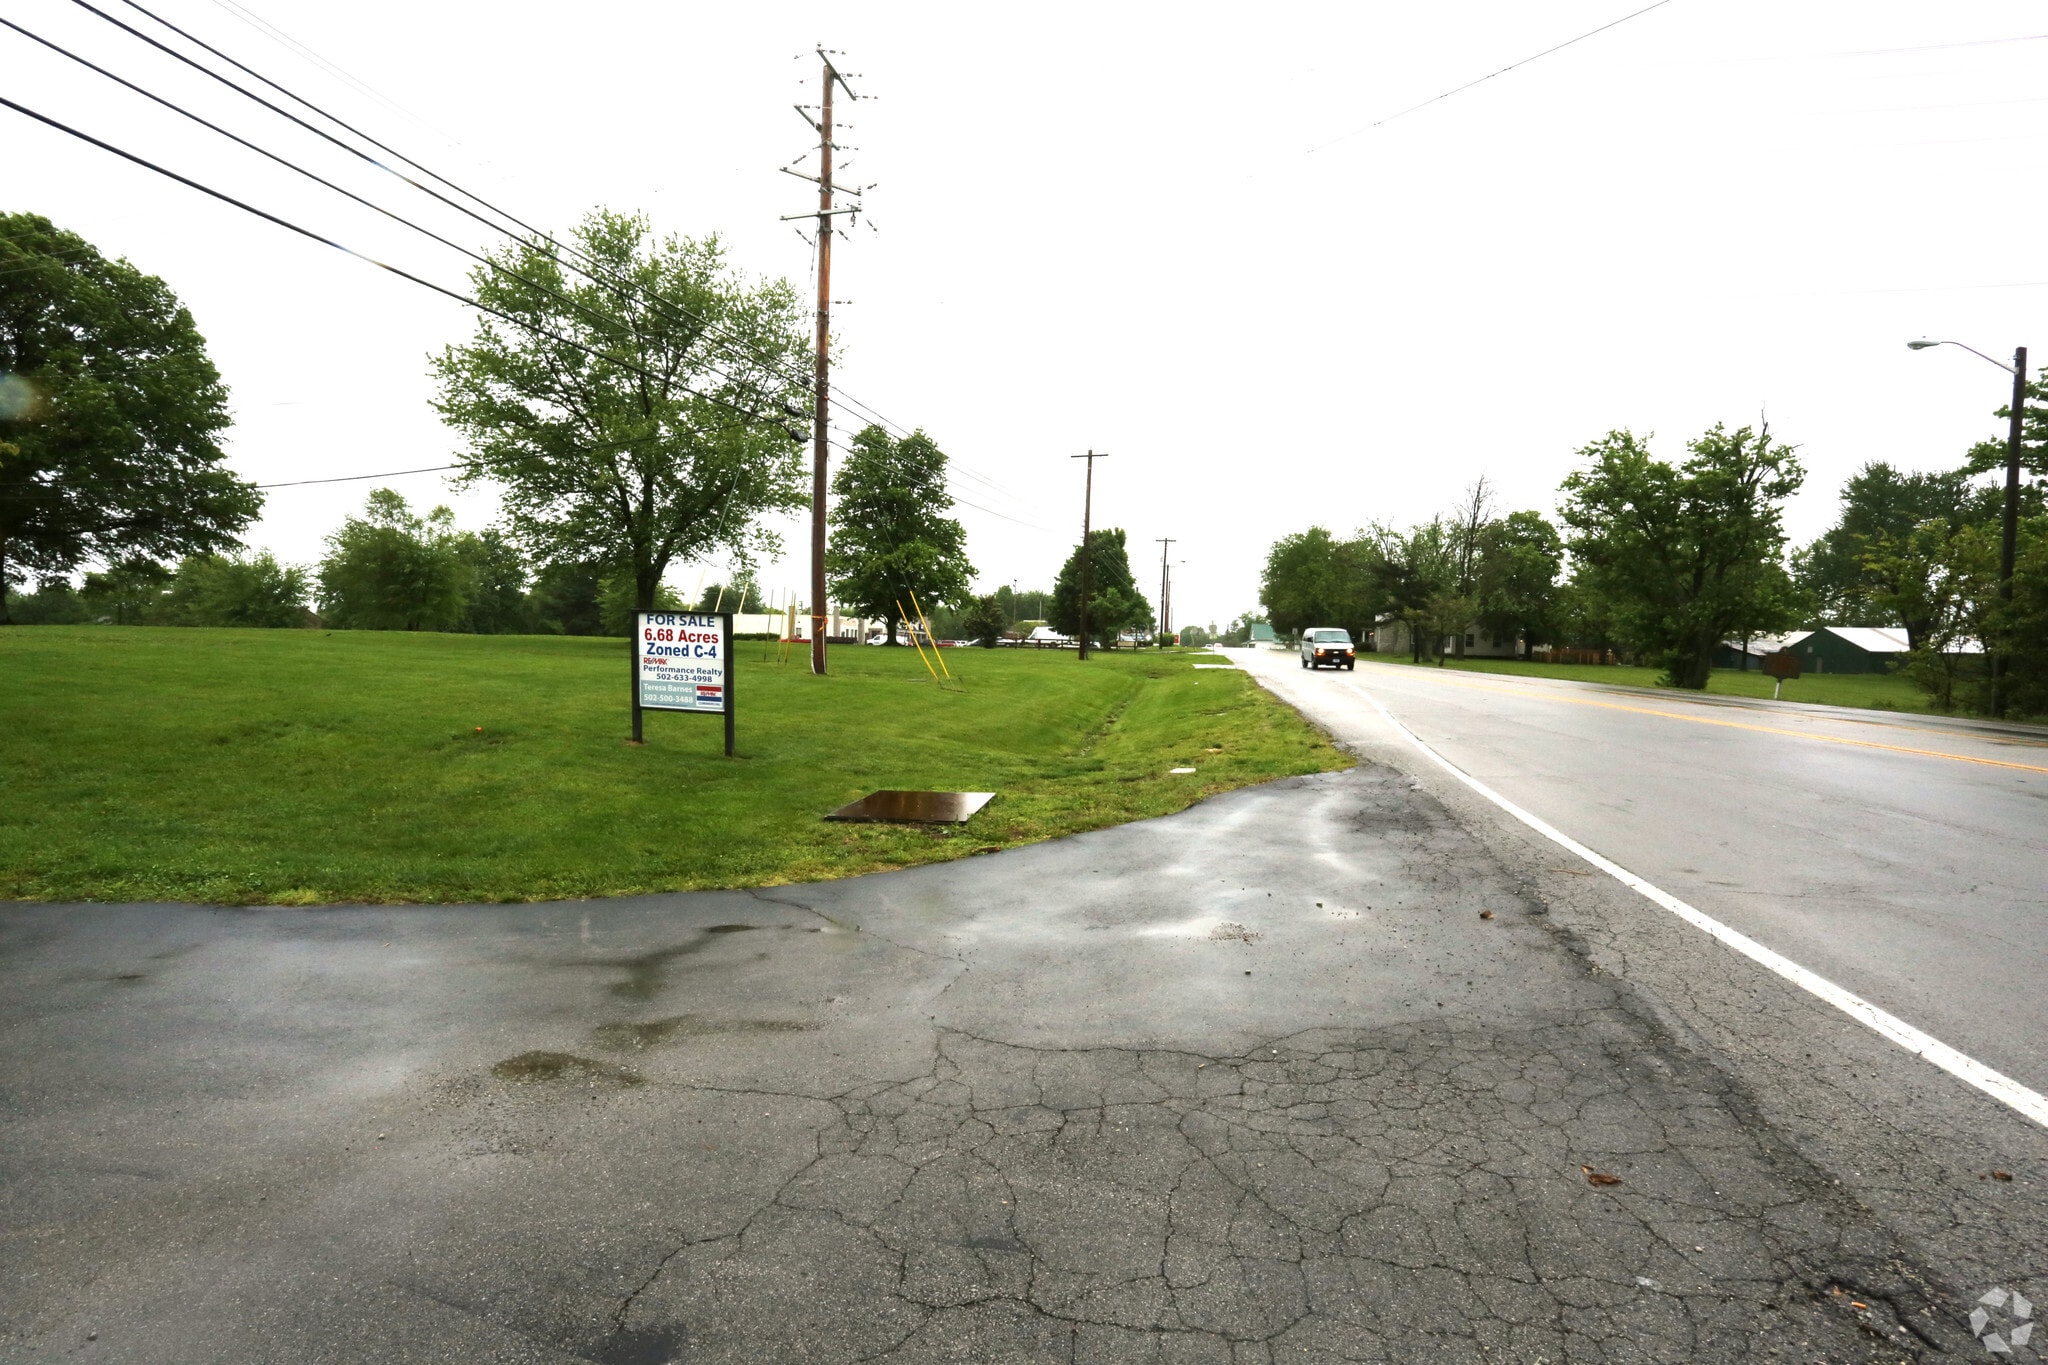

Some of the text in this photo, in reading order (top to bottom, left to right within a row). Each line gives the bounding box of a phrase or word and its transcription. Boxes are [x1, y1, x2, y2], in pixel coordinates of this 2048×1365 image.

[647, 614, 715, 627] FOR SALE
[645, 628, 719, 644] 6.68 Acres
[646, 642, 716, 658] Zoned C-4
[644, 665, 722, 677] Performance Realty
[656, 674, 712, 682] 502-633-4998
[644, 684, 692, 693] Teresa Barnes
